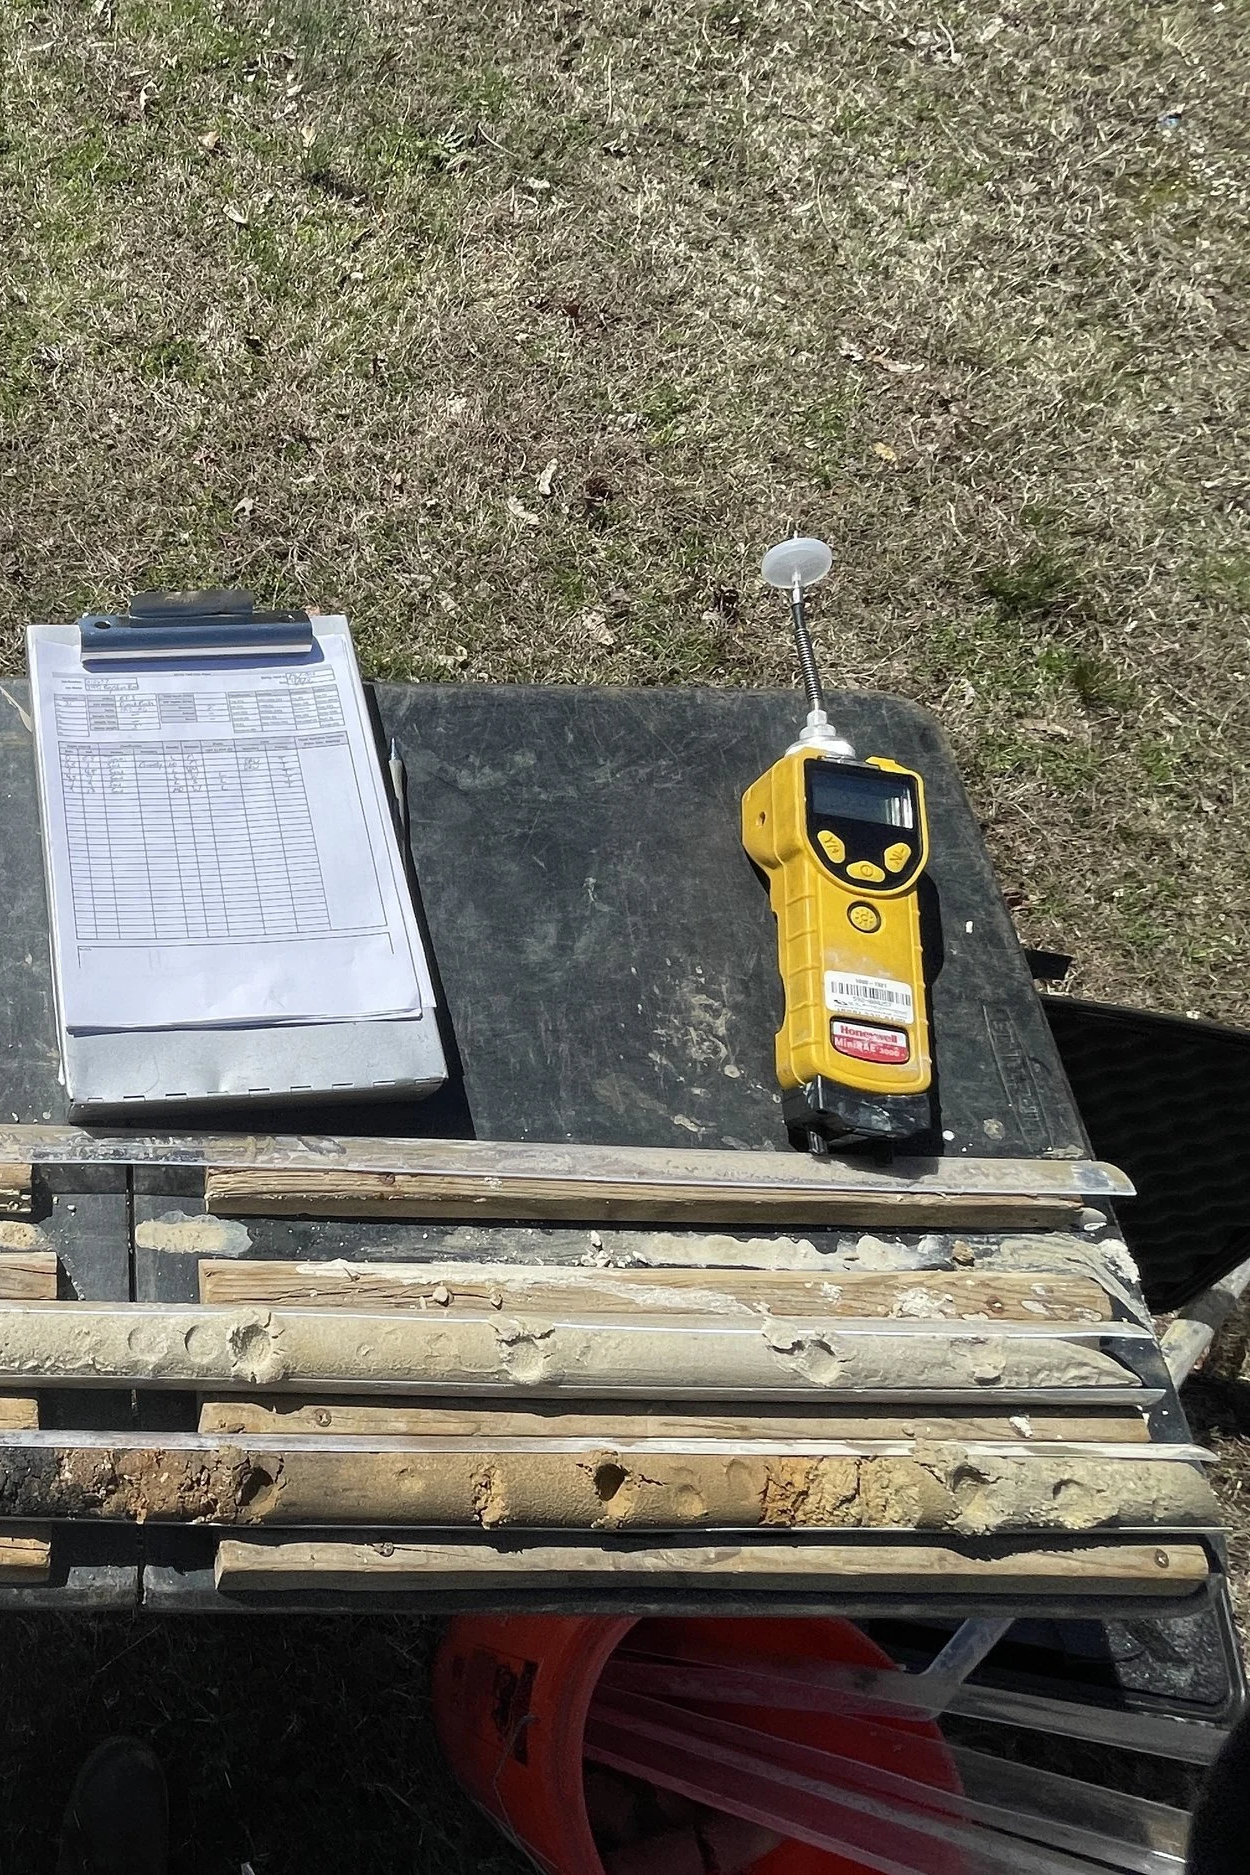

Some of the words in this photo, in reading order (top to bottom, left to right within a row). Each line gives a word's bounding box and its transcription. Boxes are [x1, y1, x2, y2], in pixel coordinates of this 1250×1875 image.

[840, 1025, 897, 1043] Honeywell
[835, 1037, 876, 1052] MiniRAE
[880, 1047, 900, 1057] 3000
